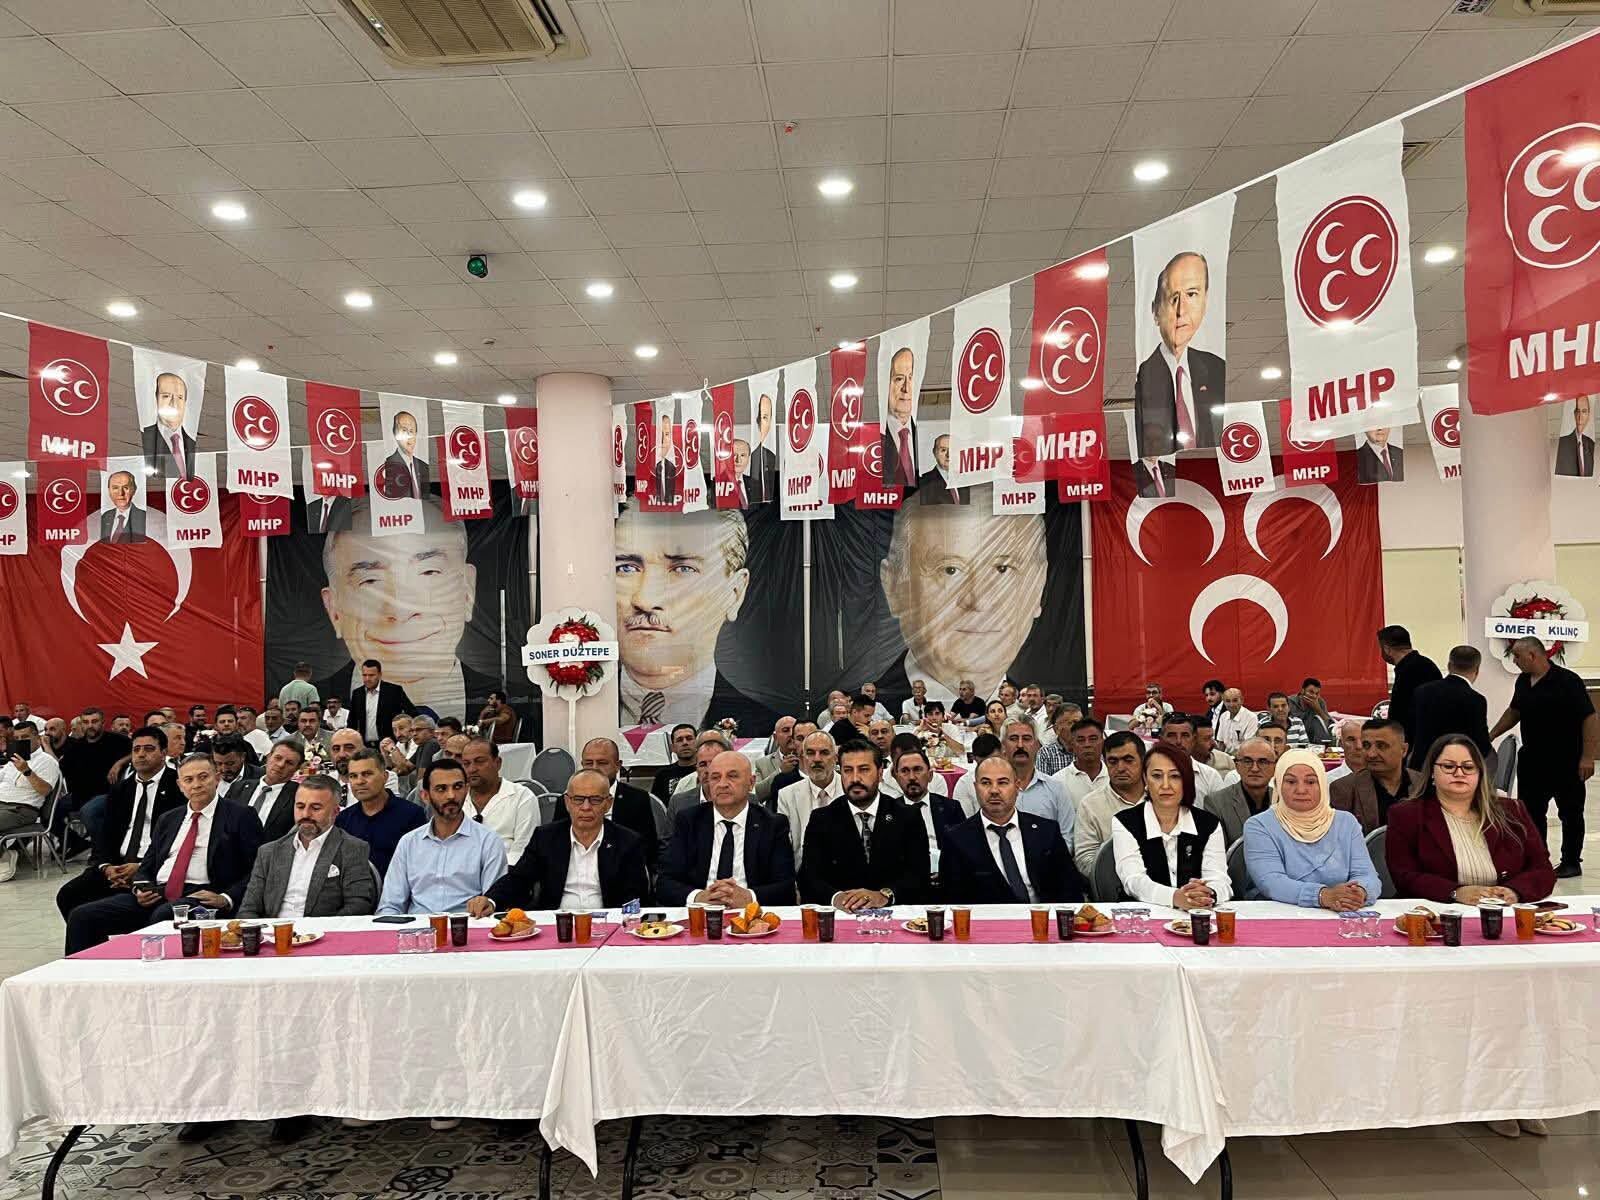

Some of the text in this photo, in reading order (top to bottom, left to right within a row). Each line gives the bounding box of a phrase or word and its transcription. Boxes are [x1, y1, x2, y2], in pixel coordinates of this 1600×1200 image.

[1307, 367, 1396, 422] MHP
[41, 434, 96, 458] MHP
[1036, 429, 1097, 462] MHP
[959, 445, 1004, 474] MHP
[238, 469, 279, 487] MHP
[1292, 465, 1330, 480] MHP
[321, 472, 358, 489] MHP
[788, 475, 812, 496] MHP
[1227, 475, 1265, 491] MHP
[457, 487, 484, 500] MHP
[715, 481, 735, 496] HP
[1067, 483, 1104, 497] MHP
[863, 492, 899, 505] MHP
[1002, 492, 1037, 506] MHP
[248, 518, 283, 531] MHP
[379, 515, 413, 528] MHP
[0, 534, 17, 546] HP
[45, 528, 81, 541] MHP
[176, 528, 211, 541] MHP
[1495, 622, 1536, 635] ÖMER
[529, 646, 610, 660] SONER DÜZTEPE
